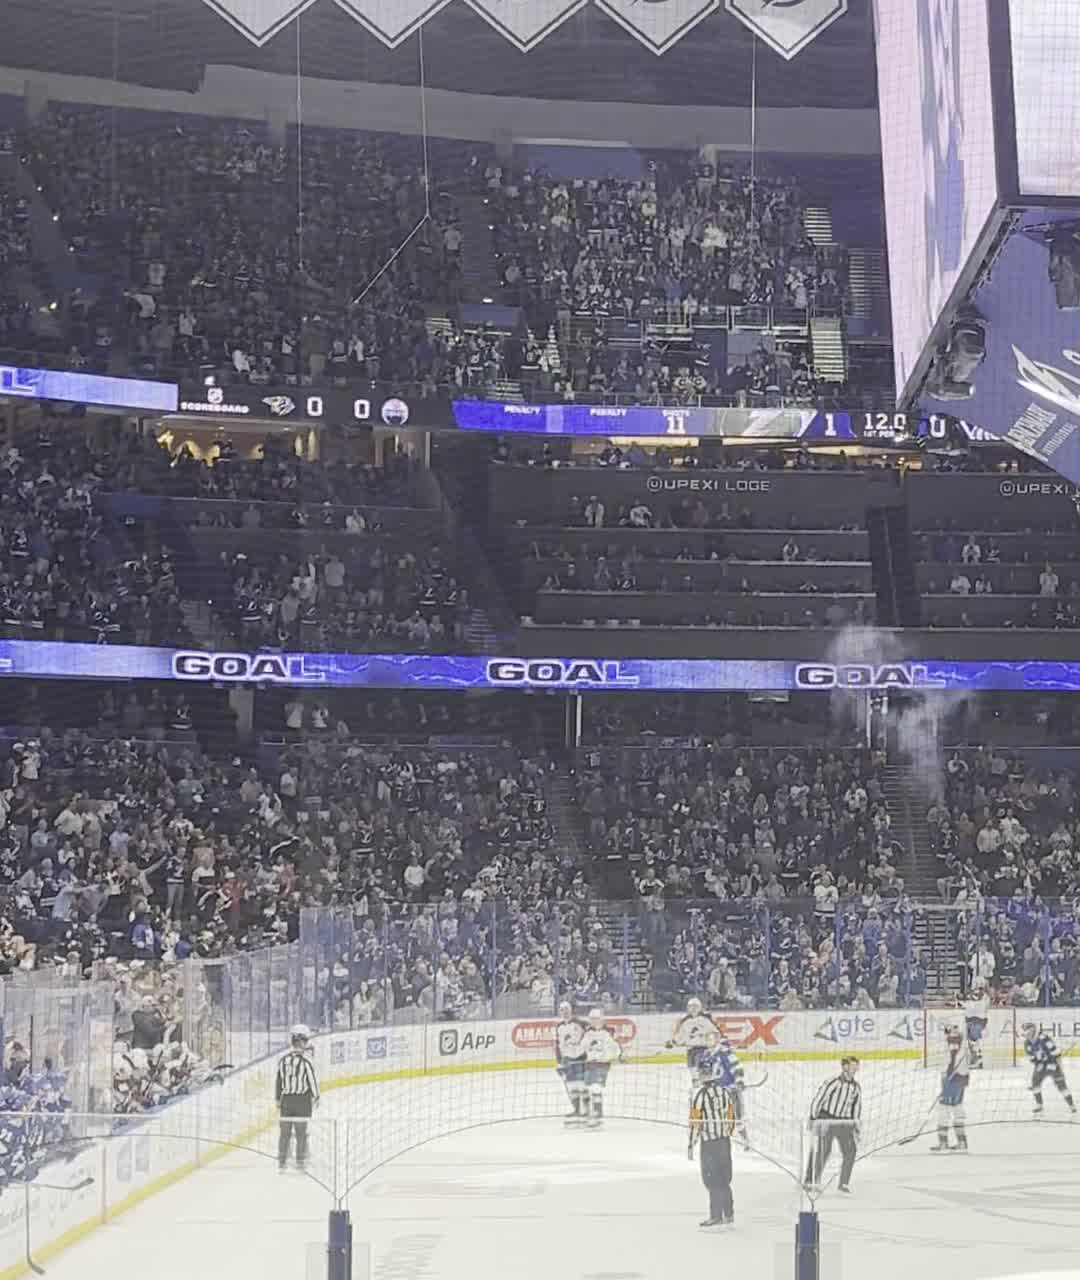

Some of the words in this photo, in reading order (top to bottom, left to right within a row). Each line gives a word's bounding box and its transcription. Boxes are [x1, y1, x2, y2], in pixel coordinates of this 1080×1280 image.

[180, 401, 250, 414] SCOREBOARD
[307, 396, 324, 417] 0
[354, 399, 371, 419] 0
[503, 405, 542, 415] PENALTY
[590, 408, 627, 417] PENALTY
[666, 417, 686, 434] 11
[824, 414, 837, 436] 1
[664, 479, 718, 490] UPEXI
[725, 480, 771, 491] LOGE
[1016, 483, 1069, 495] UPEXI
[172, 651, 326, 680] GOAL
[486, 658, 640, 687] GOAL
[796, 663, 946, 688] GOAL
